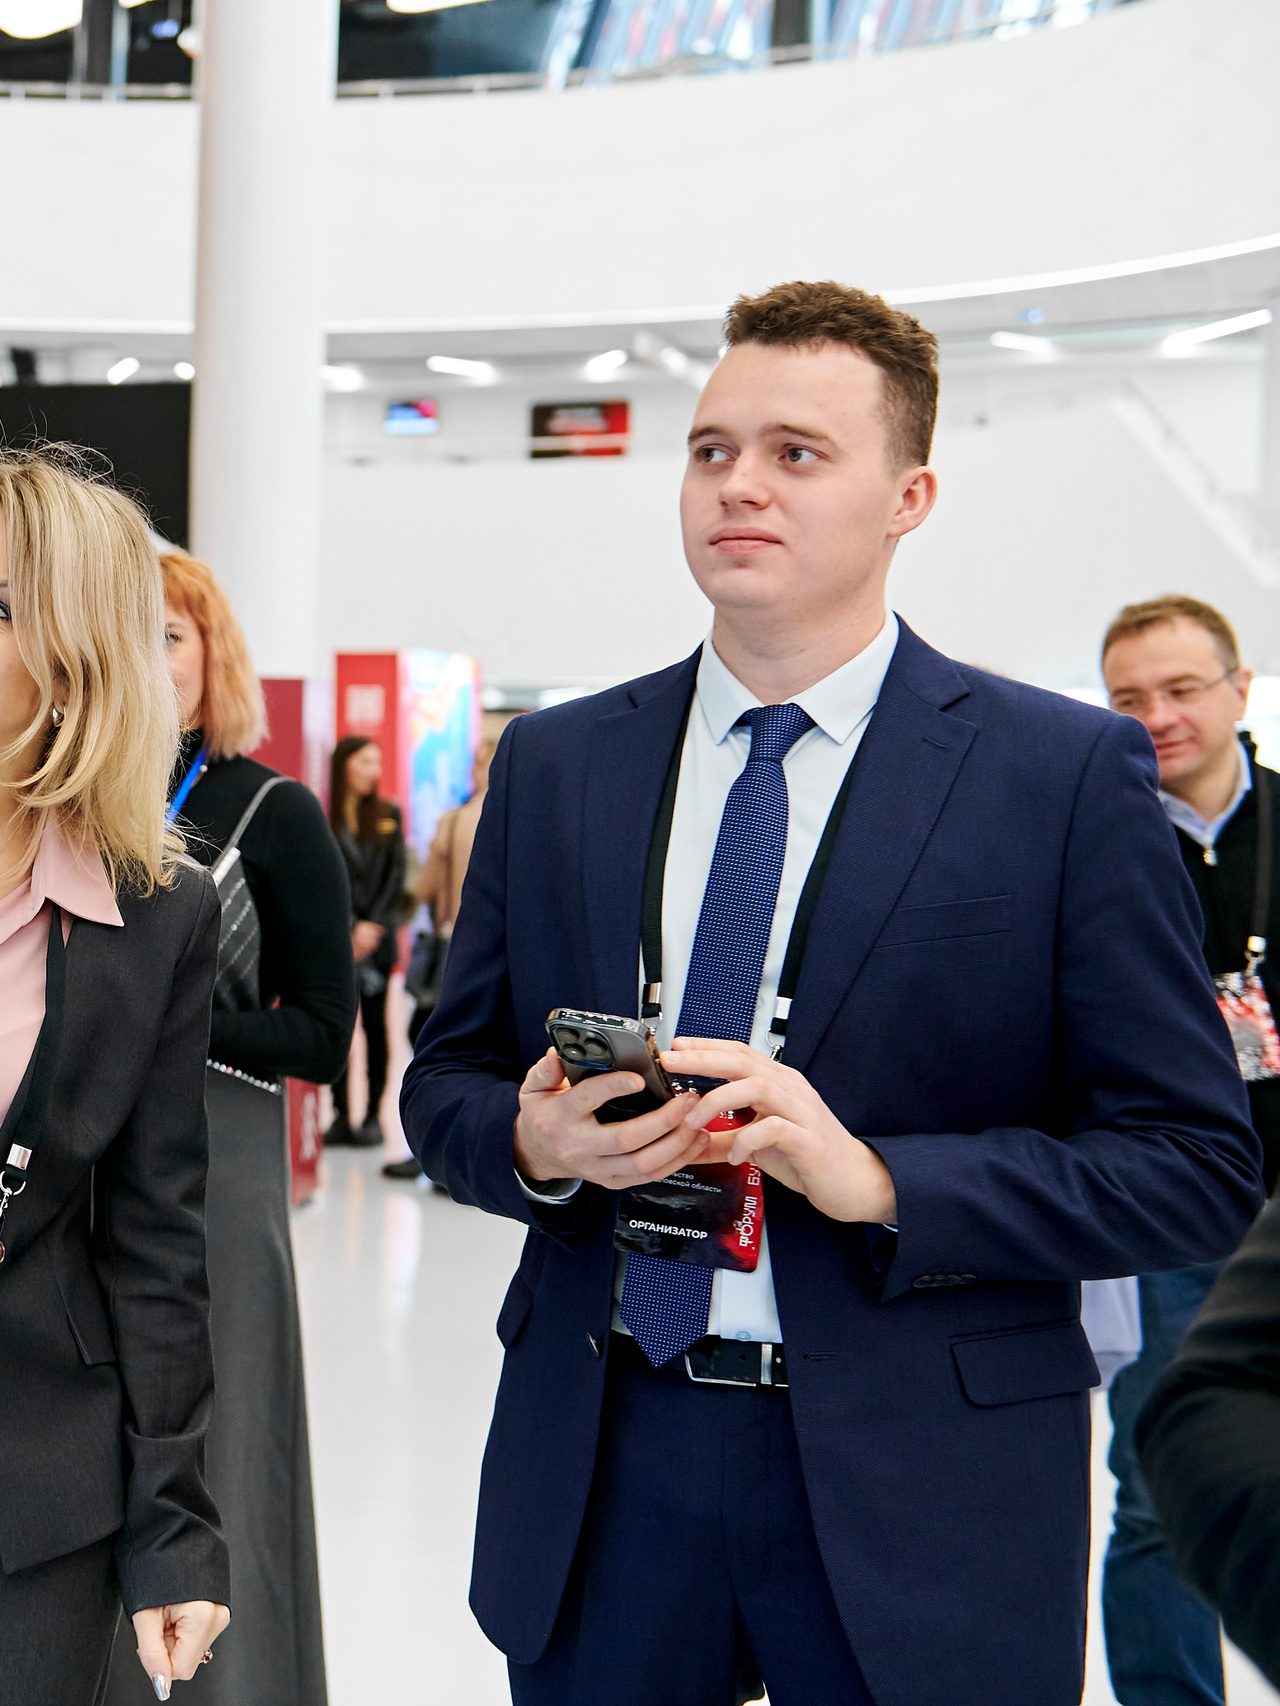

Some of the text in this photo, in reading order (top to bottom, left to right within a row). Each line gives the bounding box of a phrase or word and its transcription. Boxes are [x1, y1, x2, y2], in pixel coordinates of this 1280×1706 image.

[691, 1183, 722, 1194] области
[628, 1219, 708, 1240] ОРГАНИЗАТОР
[738, 1195, 758, 1248] ФОРУМ
